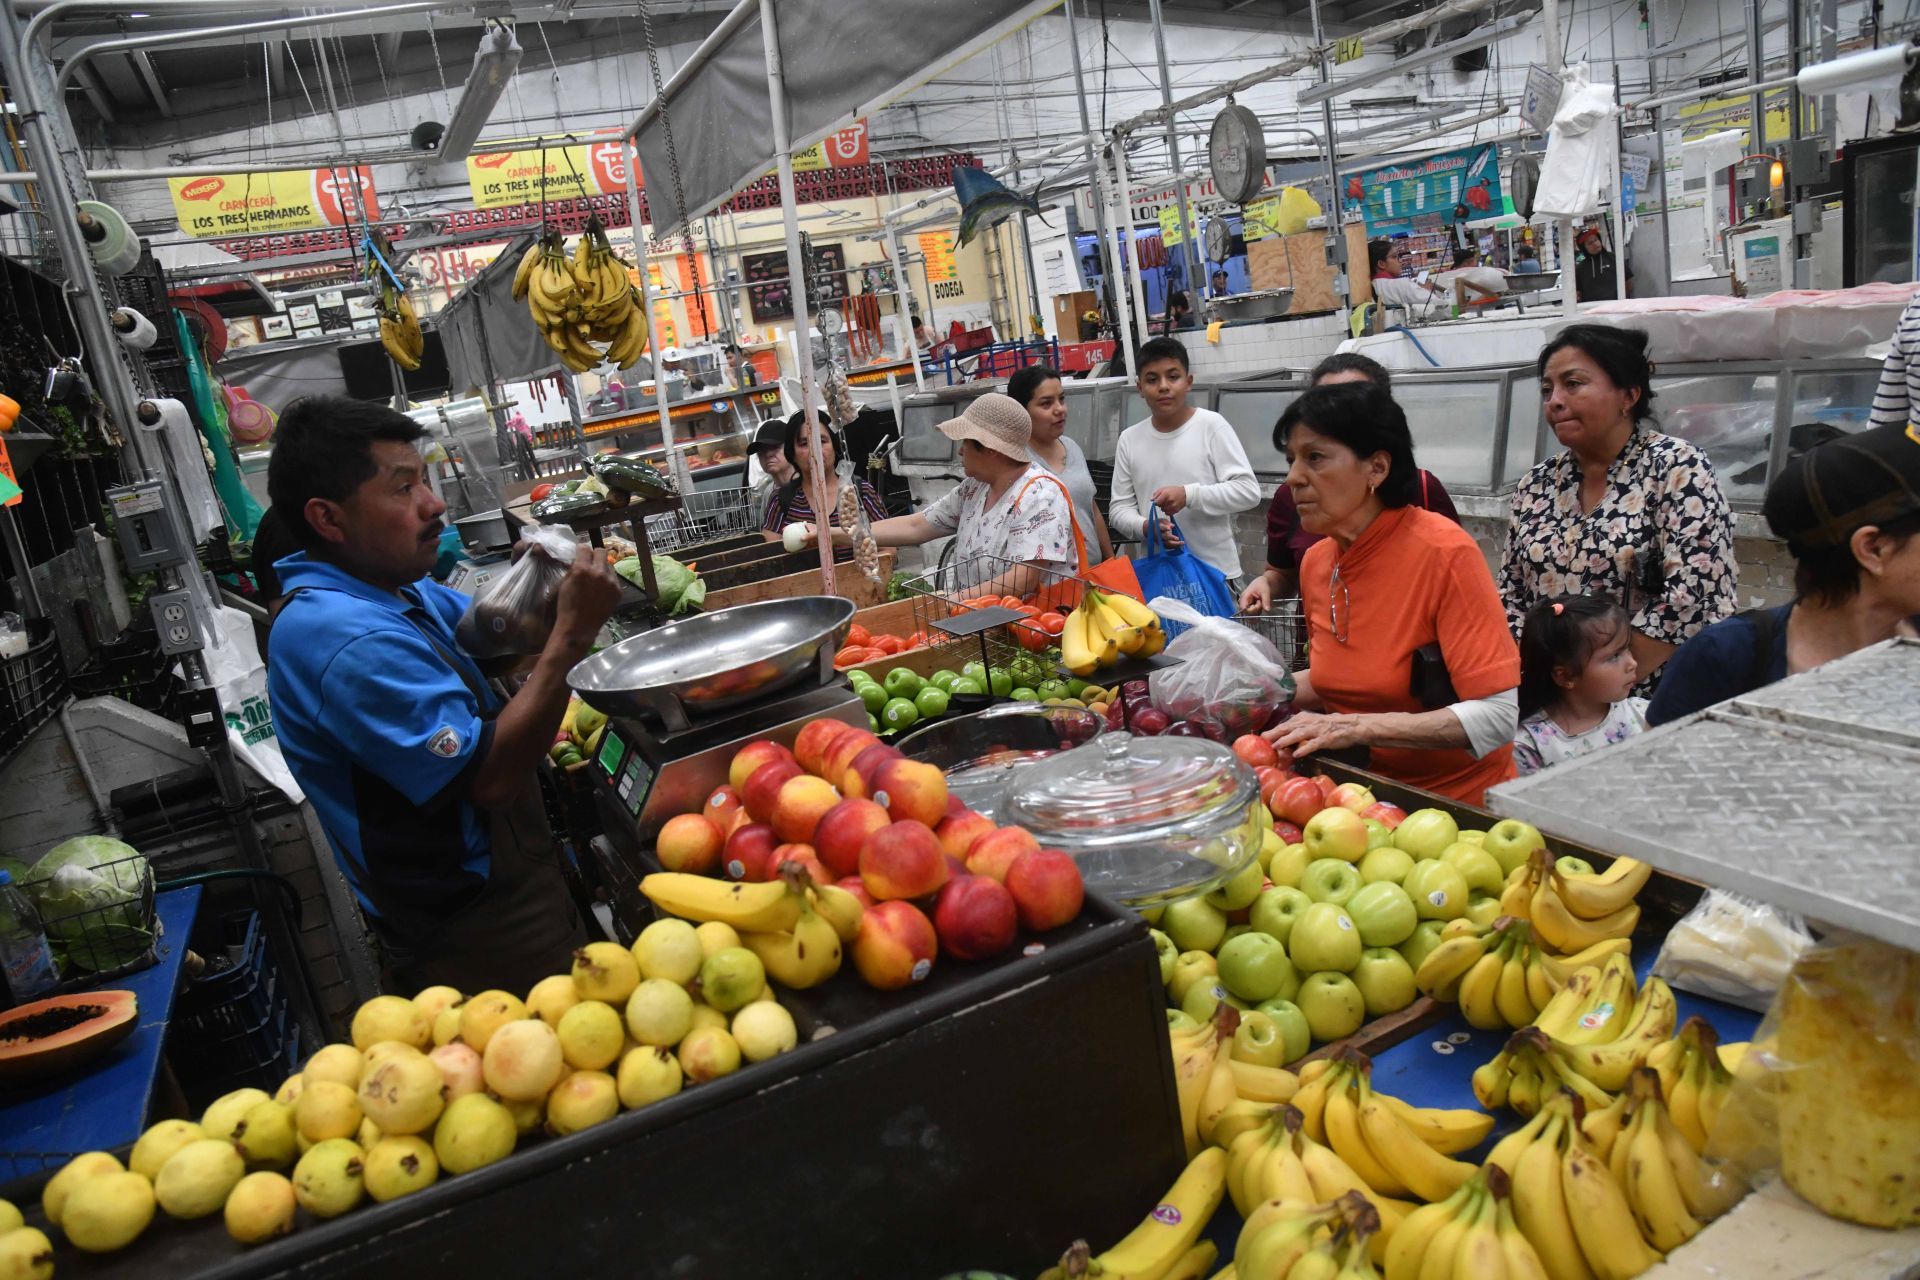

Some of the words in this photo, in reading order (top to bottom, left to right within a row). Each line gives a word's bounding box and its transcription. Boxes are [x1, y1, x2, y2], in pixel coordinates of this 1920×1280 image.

[484, 184, 502, 195] LOS
[505, 180, 529, 192] TRES
[533, 173, 585, 188] HRMANOS
[219, 195, 277, 212] CARNCERÍA
[194, 218, 214, 229] LOS
[217, 213, 245, 226] TRES
[250, 205, 310, 223] HERMANOS
[421, 255, 441, 285] 3
[935, 281, 965, 299] BODEGA
[1086, 349, 1103, 365] 145
